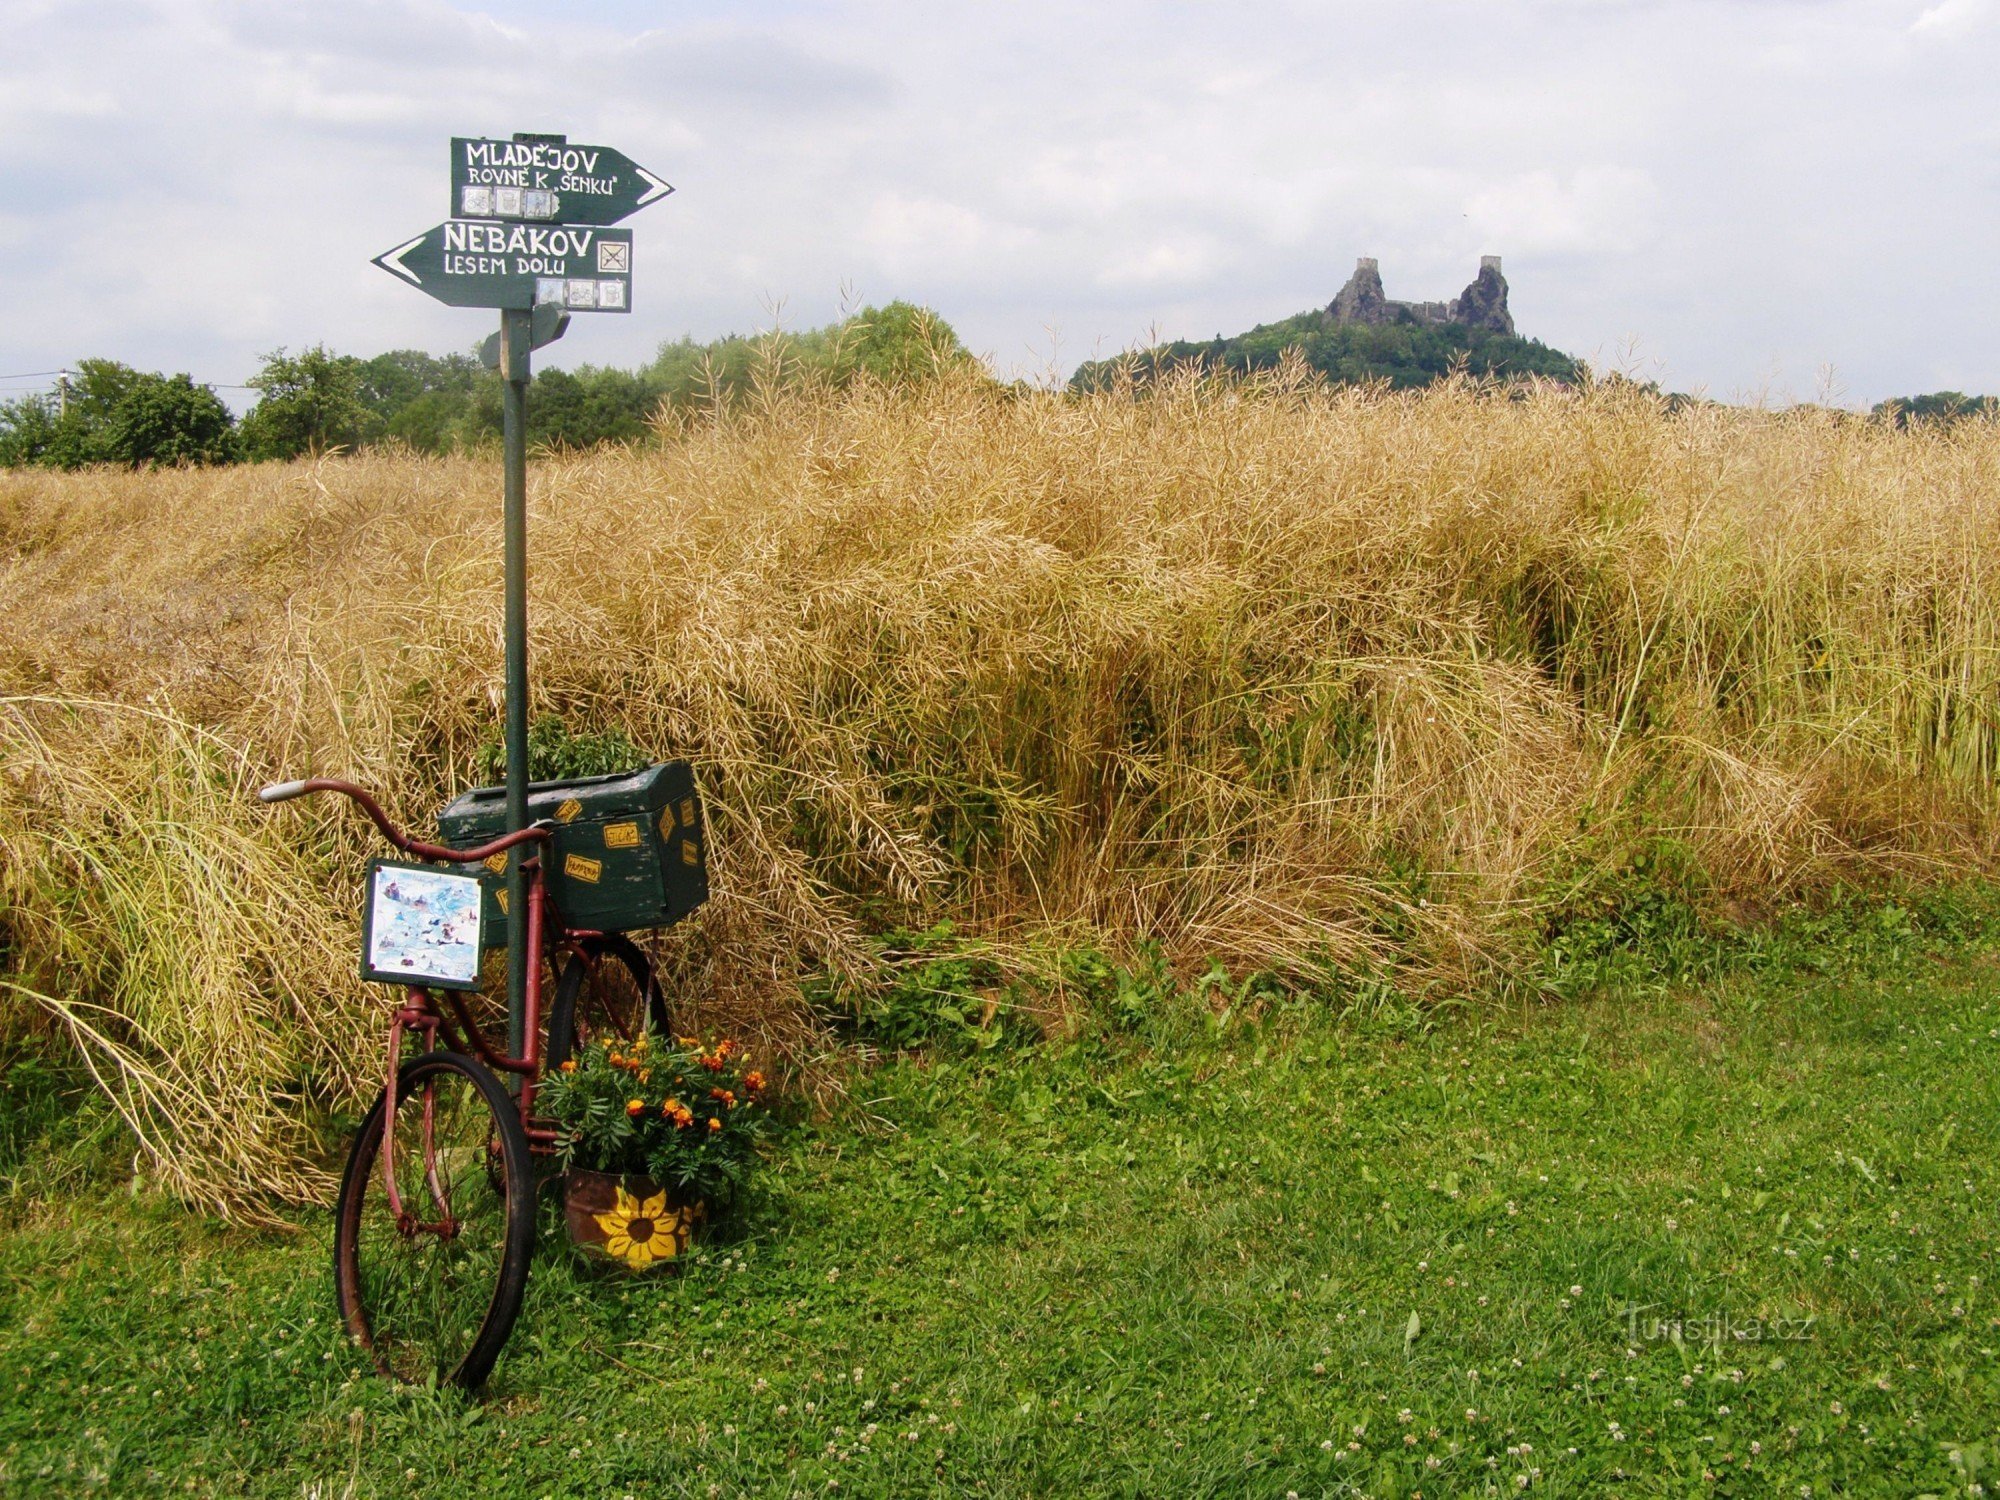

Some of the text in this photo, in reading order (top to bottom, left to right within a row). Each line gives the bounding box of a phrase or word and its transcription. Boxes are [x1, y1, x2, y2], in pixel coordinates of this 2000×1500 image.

[466, 143, 599, 173] MLADĚJOV
[468, 167, 530, 187] ROVNĚ
[535, 171, 549, 188] K
[443, 223, 593, 257] NEBÁKOV
[445, 253, 566, 275] LESEM DOLU
